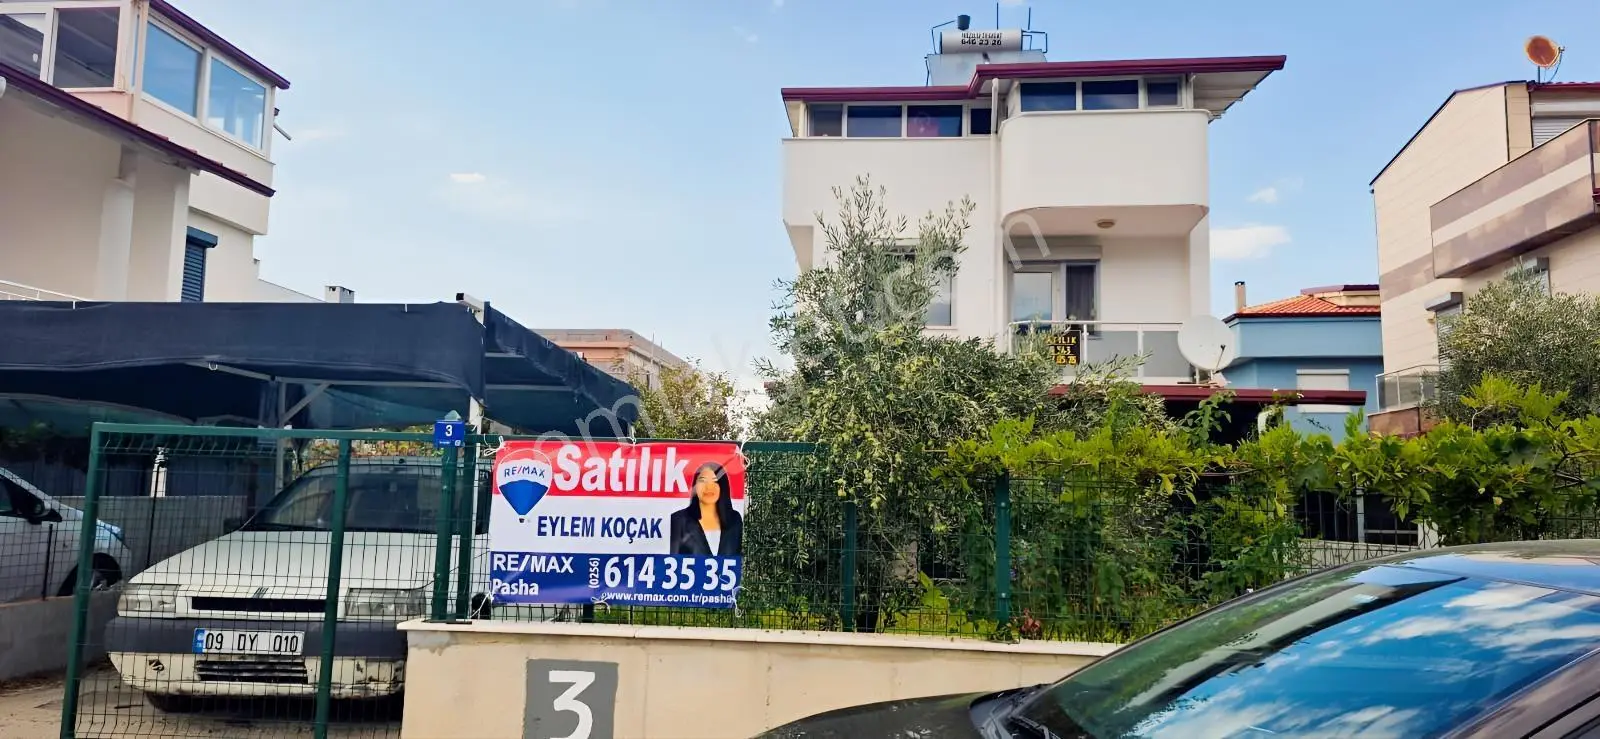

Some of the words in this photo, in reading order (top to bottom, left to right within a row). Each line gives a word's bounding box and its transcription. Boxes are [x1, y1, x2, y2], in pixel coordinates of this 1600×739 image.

[445, 424, 453, 437] 3
[504, 465, 545, 478] RE/MAX
[553, 444, 690, 493] Satılık
[537, 516, 595, 538] EYLEM
[600, 517, 663, 544] KOÇAK
[493, 553, 574, 574] RE/MAX
[588, 557, 600, 589] (0256)
[604, 556, 656, 589] 614
[661, 556, 695, 590] 35
[702, 558, 737, 591] 35
[492, 579, 539, 596] Pasha
[205, 632, 224, 651] 09
[237, 633, 258, 652] DY
[273, 634, 299, 653] 010
[548, 670, 596, 739] 3
